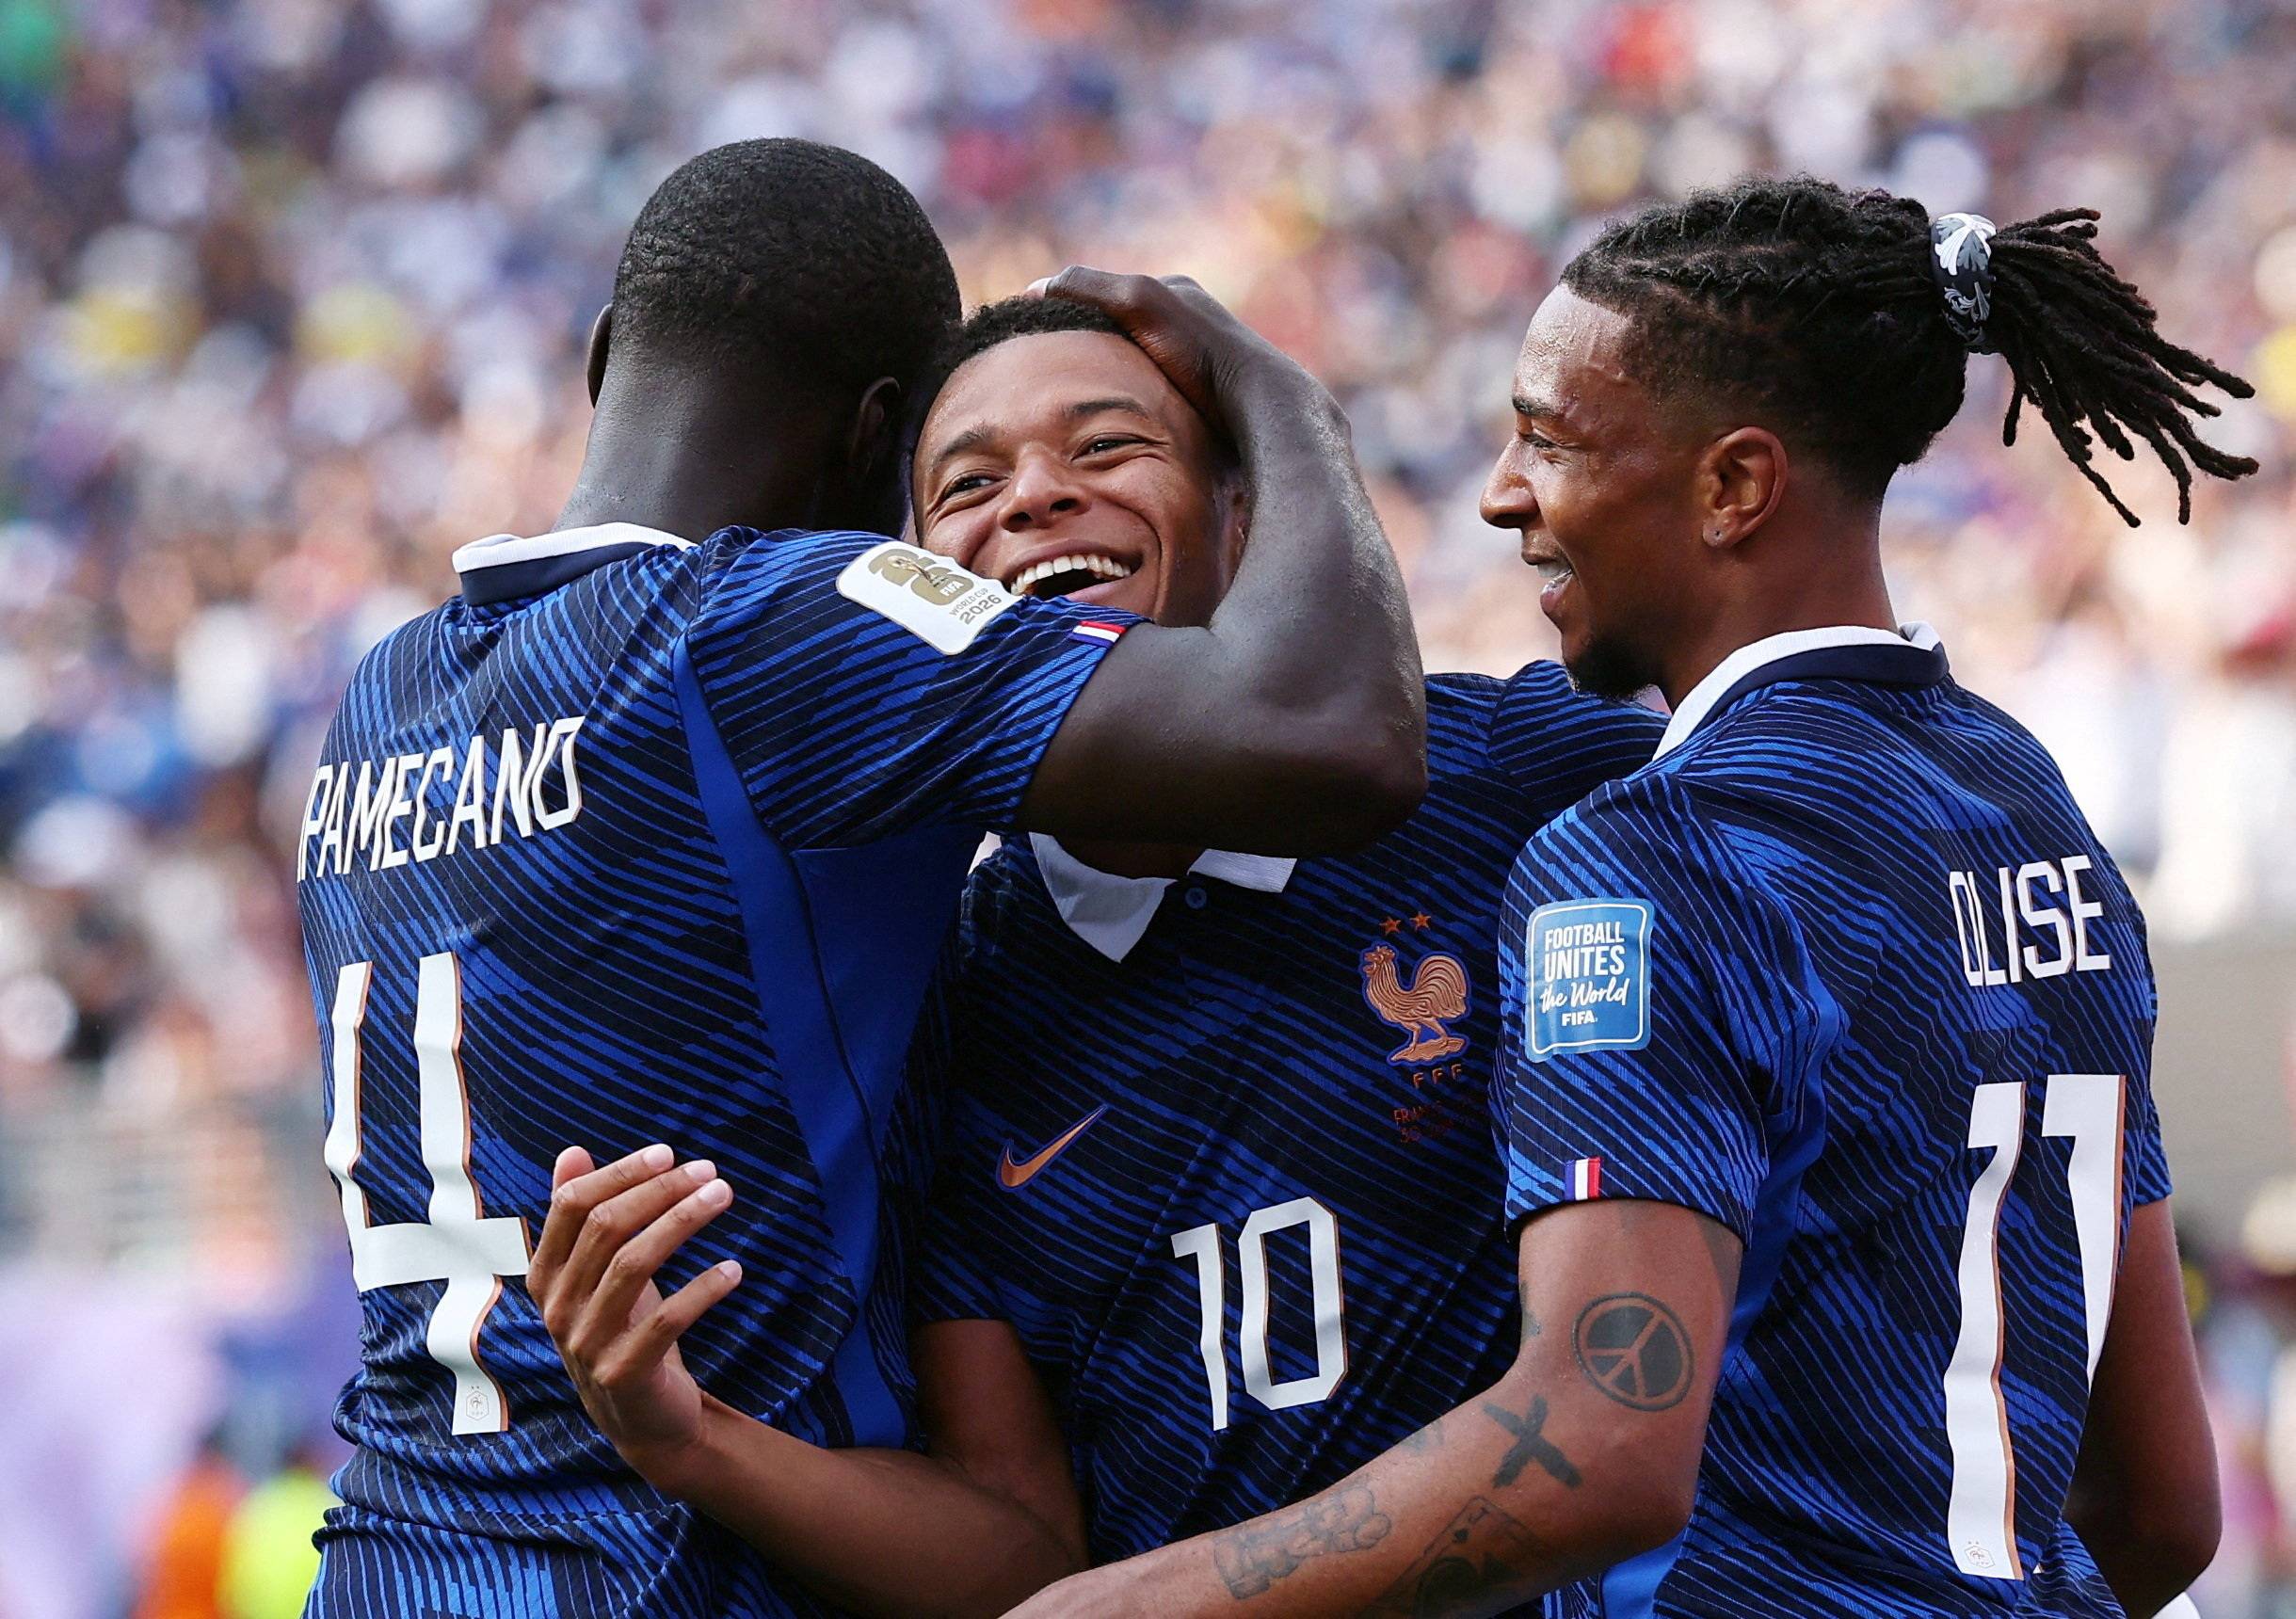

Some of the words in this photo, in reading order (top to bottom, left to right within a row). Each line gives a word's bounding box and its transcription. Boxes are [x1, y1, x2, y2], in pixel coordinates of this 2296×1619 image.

[949, 597, 976, 616] WORLD
[975, 588, 988, 599] CUP
[959, 594, 1003, 625] 2026
[297, 716, 586, 883] PAMECANO
[1545, 921, 1626, 952] FOOTBALL
[1950, 855, 2111, 986] OLISE
[1544, 946, 1626, 983] UNITES
[1539, 982, 1568, 1014] the
[1570, 977, 1630, 1008] World
[1562, 1009, 1597, 1027] FIFA
[324, 951, 532, 1436] 4
[1171, 1195, 1349, 1432] 10
[1944, 1074, 2127, 1581] 11
